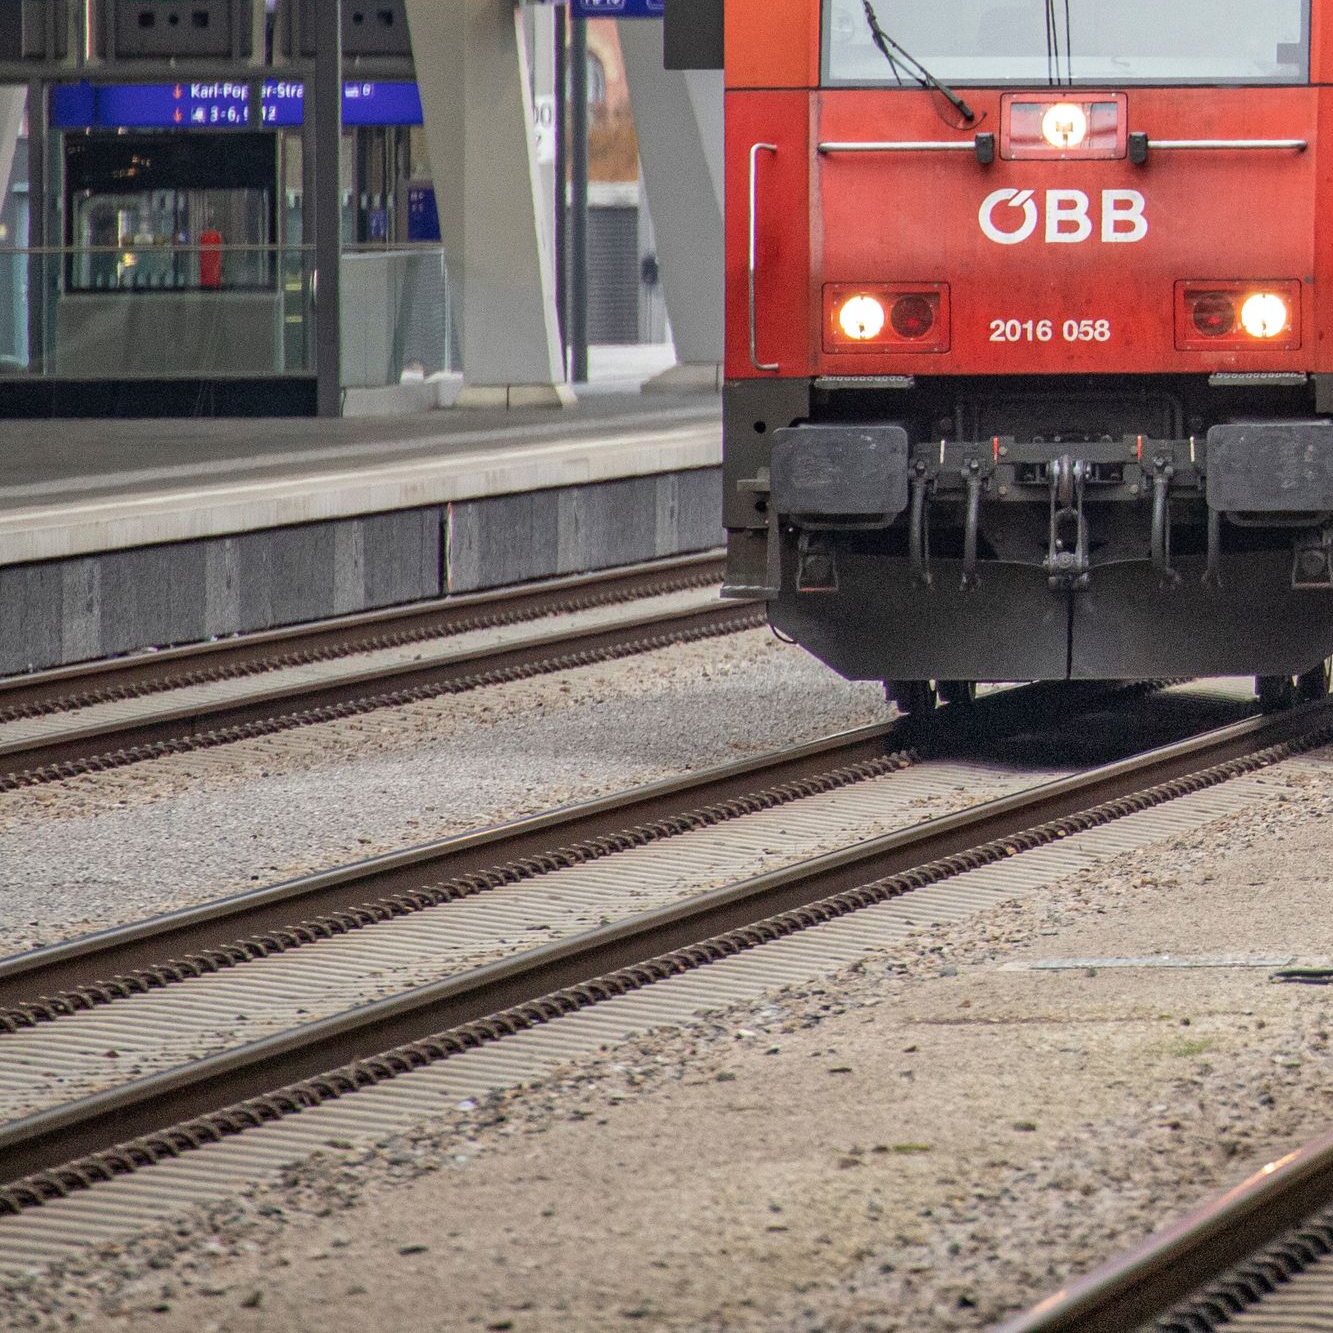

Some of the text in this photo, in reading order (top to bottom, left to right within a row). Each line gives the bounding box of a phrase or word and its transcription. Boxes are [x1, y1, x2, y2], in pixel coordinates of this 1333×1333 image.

[978, 188, 1149, 245] ÖBB
[989, 319, 1111, 342] 2016 058
